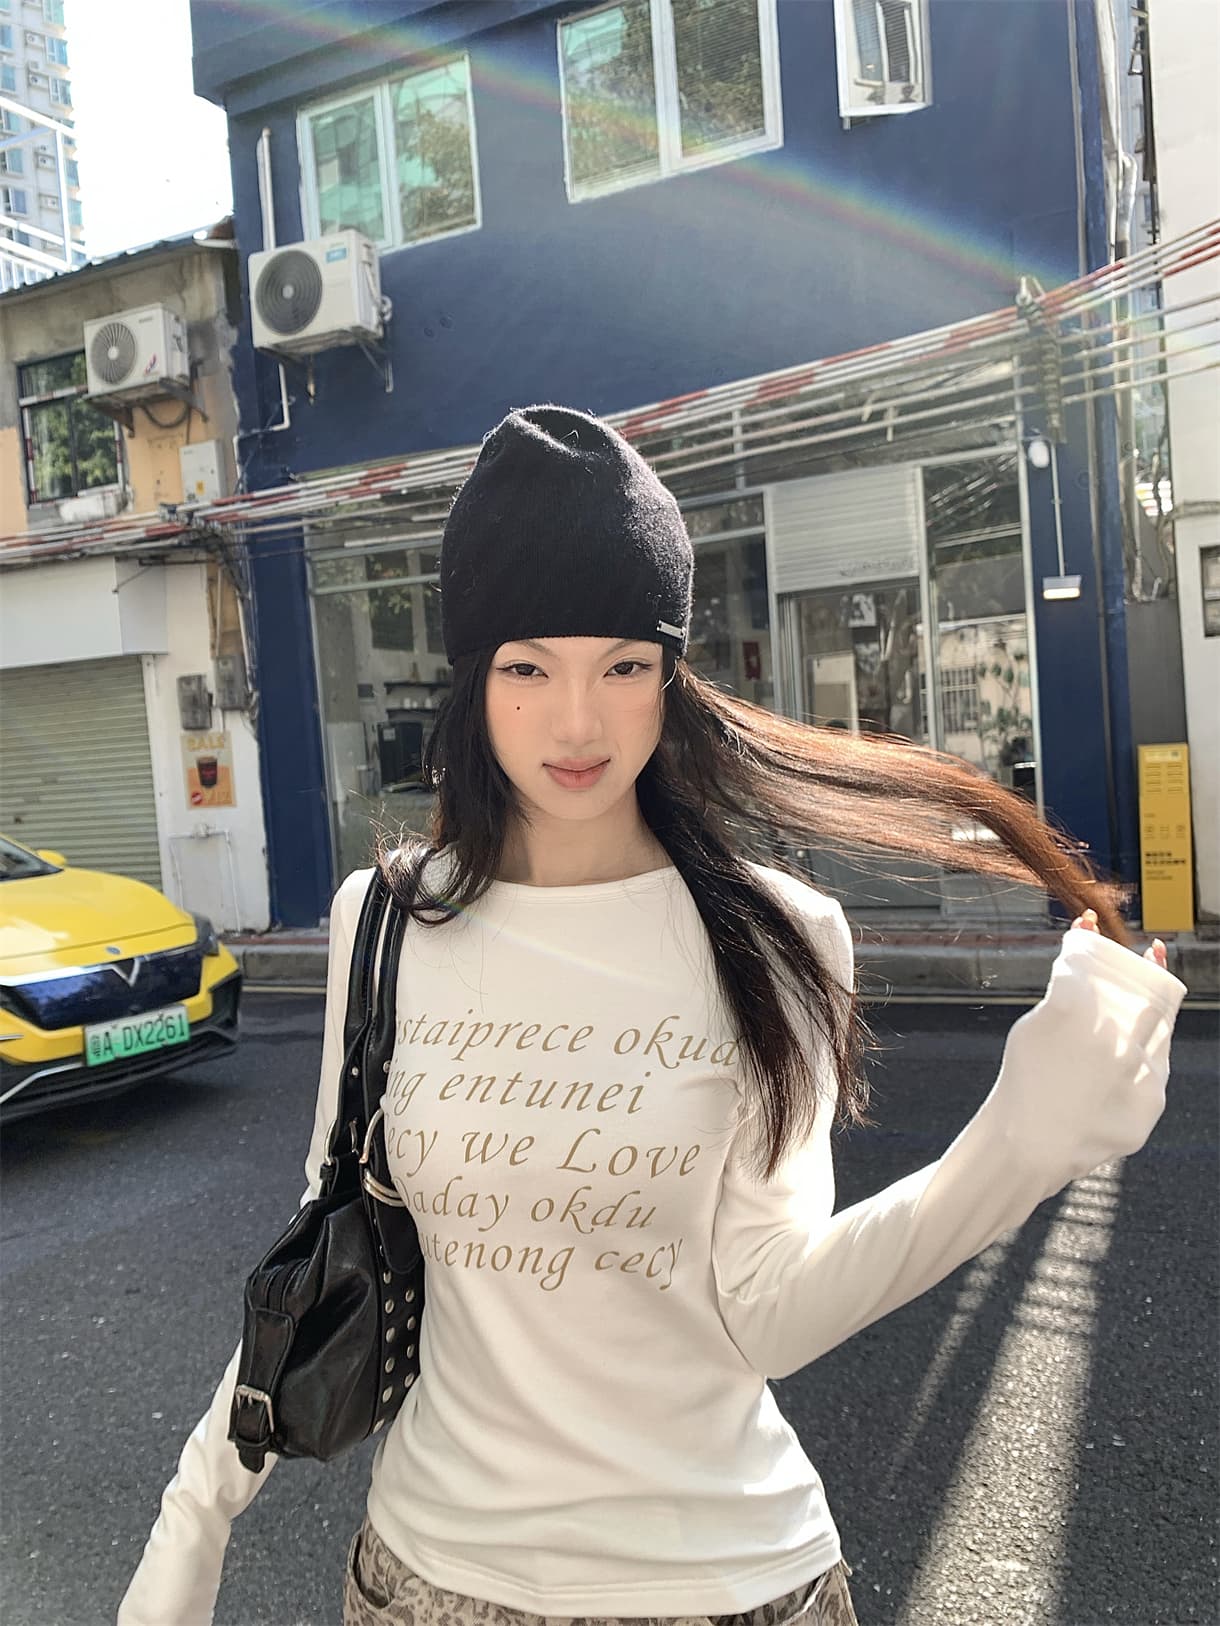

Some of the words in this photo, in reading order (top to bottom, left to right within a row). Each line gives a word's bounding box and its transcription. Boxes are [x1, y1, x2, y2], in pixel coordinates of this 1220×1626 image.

[122, 1014, 185, 1051] DX2261
[438, 1070, 652, 1115] entunei
[461, 1128, 536, 1167] we
[556, 1127, 701, 1179] Love
[531, 1185, 657, 1235] okdu
[594, 1238, 683, 1291] cecy
